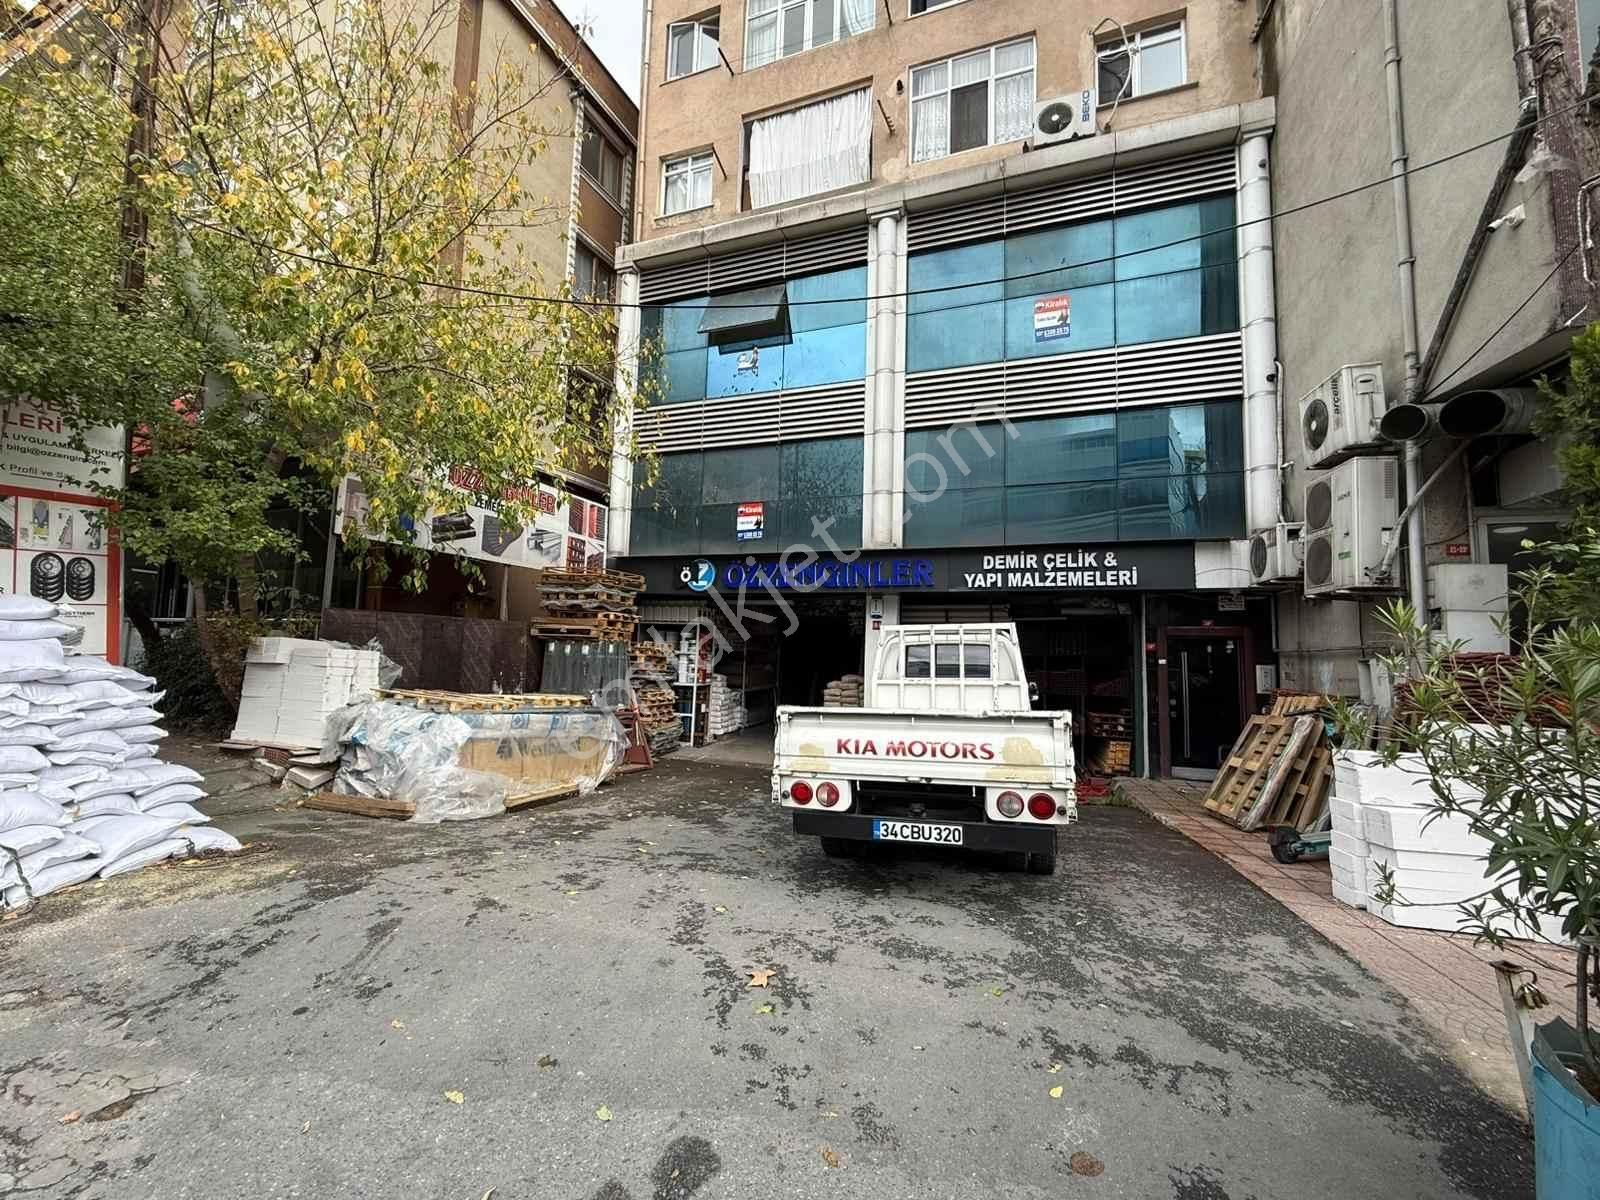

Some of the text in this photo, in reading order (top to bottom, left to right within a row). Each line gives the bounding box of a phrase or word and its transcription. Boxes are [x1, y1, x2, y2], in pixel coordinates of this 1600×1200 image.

[1082, 90, 1090, 122] BEKO
[983, 549, 1118, 572] DEMİR ÇELİK &
[964, 566, 1138, 588] YAPI MALZEMELERİ
[836, 738, 995, 760] KIA MOTORS
